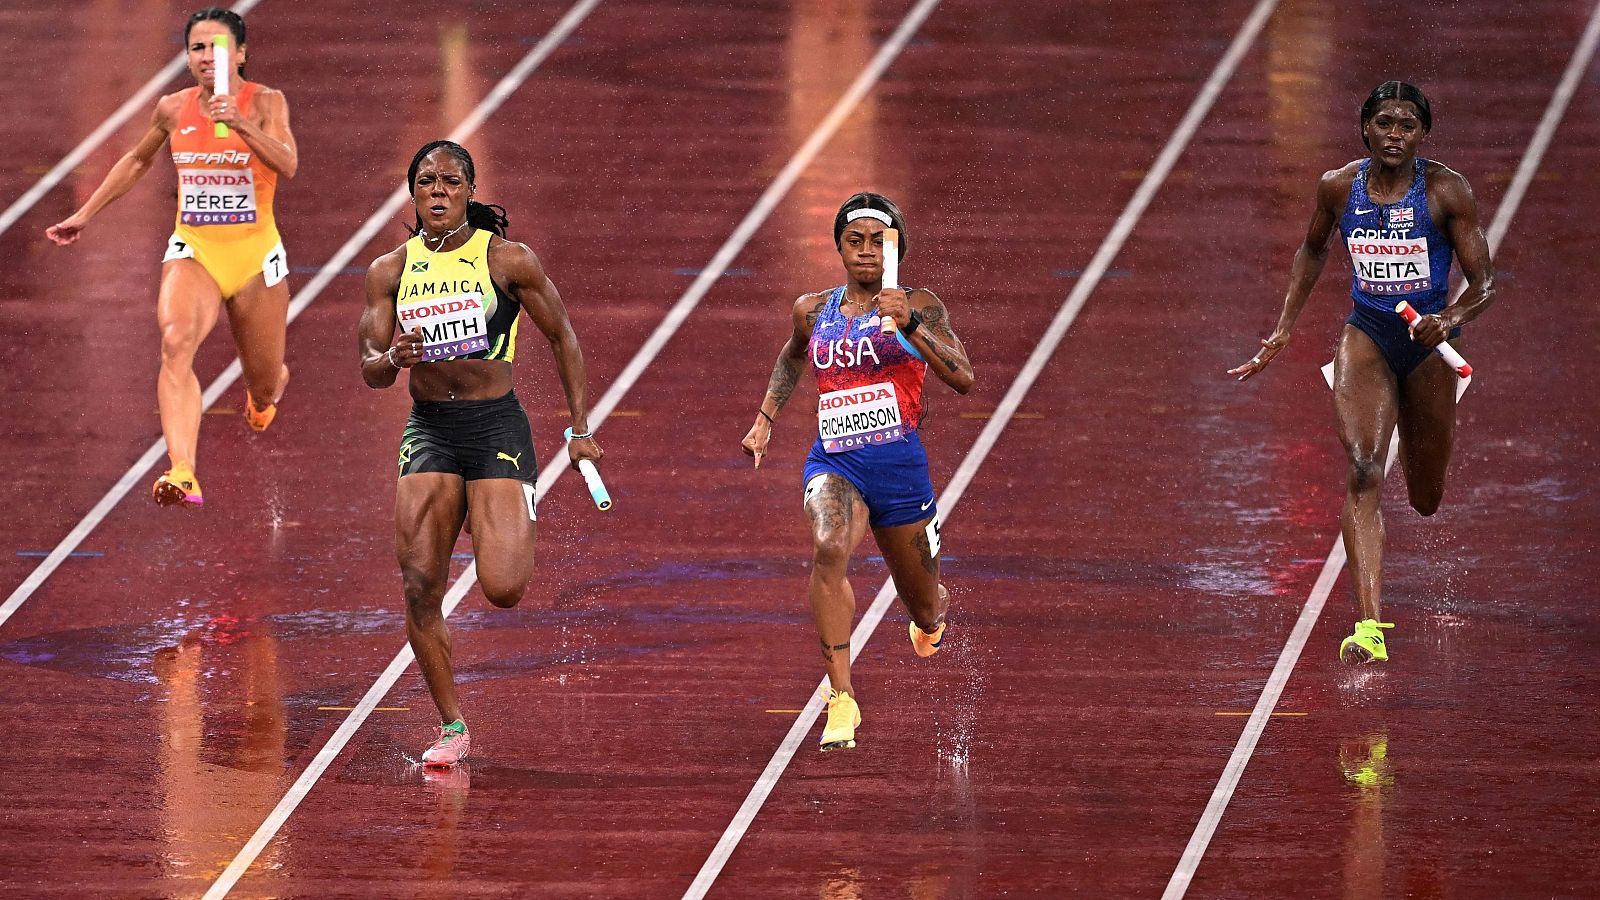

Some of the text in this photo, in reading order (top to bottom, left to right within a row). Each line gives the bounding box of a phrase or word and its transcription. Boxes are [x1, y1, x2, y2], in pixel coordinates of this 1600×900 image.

[172, 150, 250, 165] ESPAÑA
[182, 175, 251, 185] HONDA
[185, 191, 248, 209] PÉREZ
[1350, 243, 1426, 255] HONDA
[270, 254, 280, 277] 7
[1359, 262, 1419, 278] NEITA
[401, 281, 484, 300] JAMAICA
[400, 299, 481, 320] HONDA
[411, 317, 479, 343] MITH
[813, 337, 880, 369] USA
[820, 388, 894, 411] HONDA
[821, 406, 897, 436] RICHARDSON
